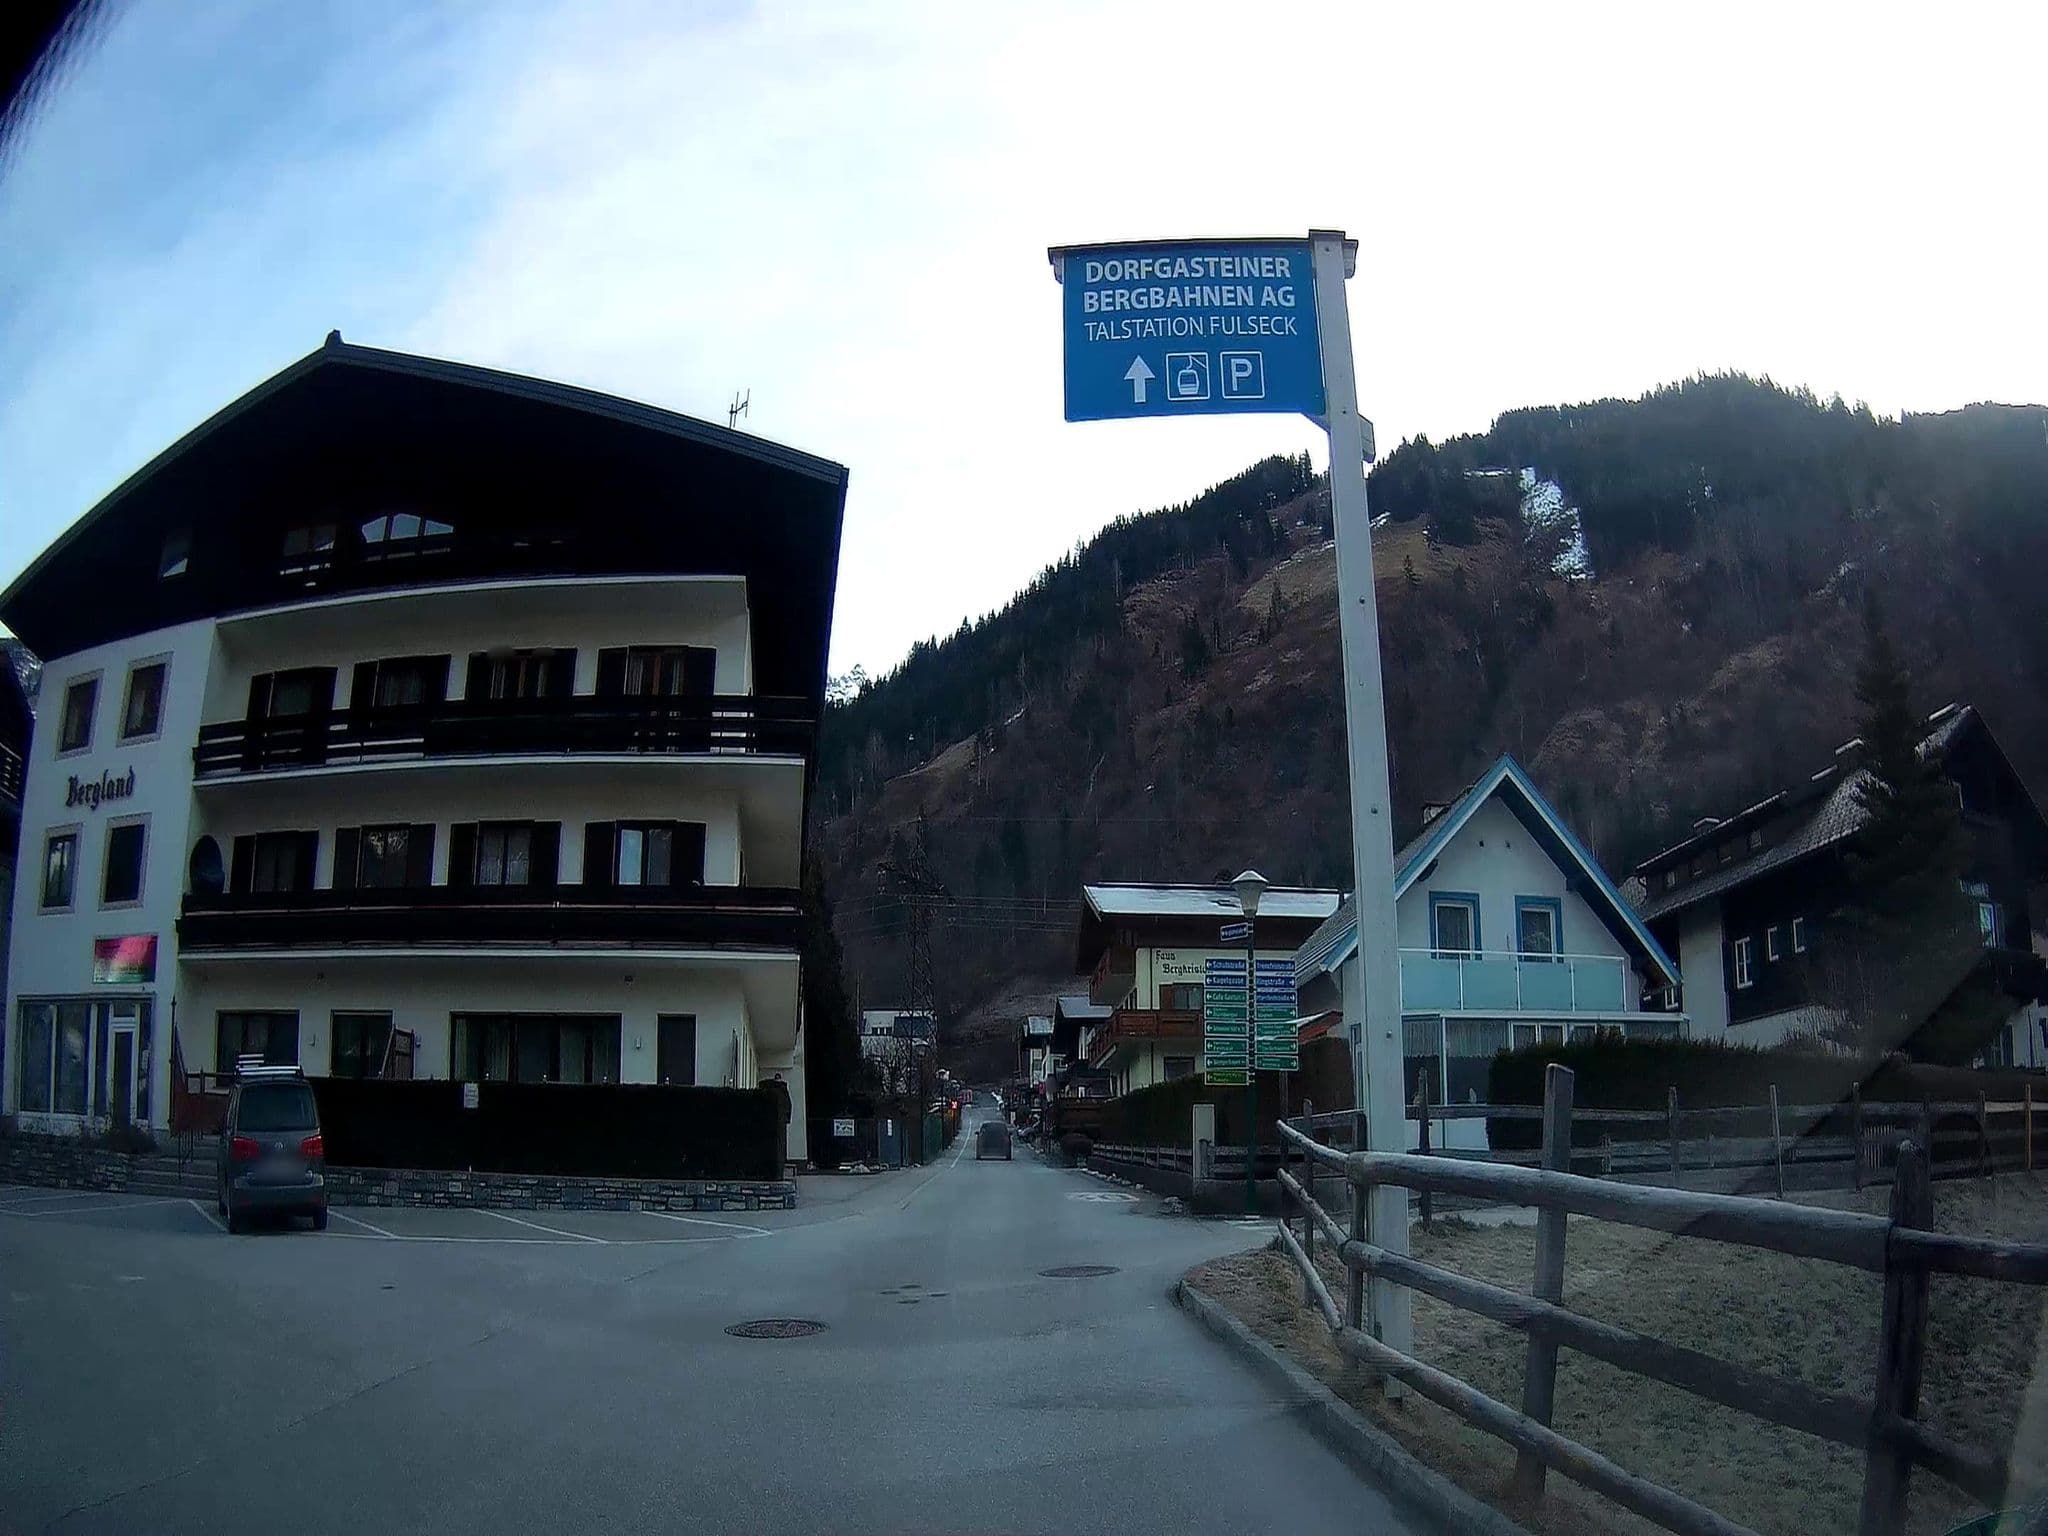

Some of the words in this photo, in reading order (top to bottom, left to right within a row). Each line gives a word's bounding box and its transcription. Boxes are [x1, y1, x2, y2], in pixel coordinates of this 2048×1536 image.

[1085, 256, 1291, 283] DORFGASTEINER
[1083, 286, 1254, 313] BERGBAHNEN
[1260, 285, 1296, 307] AG
[1084, 317, 1203, 341] TALSTATION
[1210, 315, 1298, 336] FULSECK
[1230, 358, 1252, 391] P
[65, 765, 136, 811] Bergland
